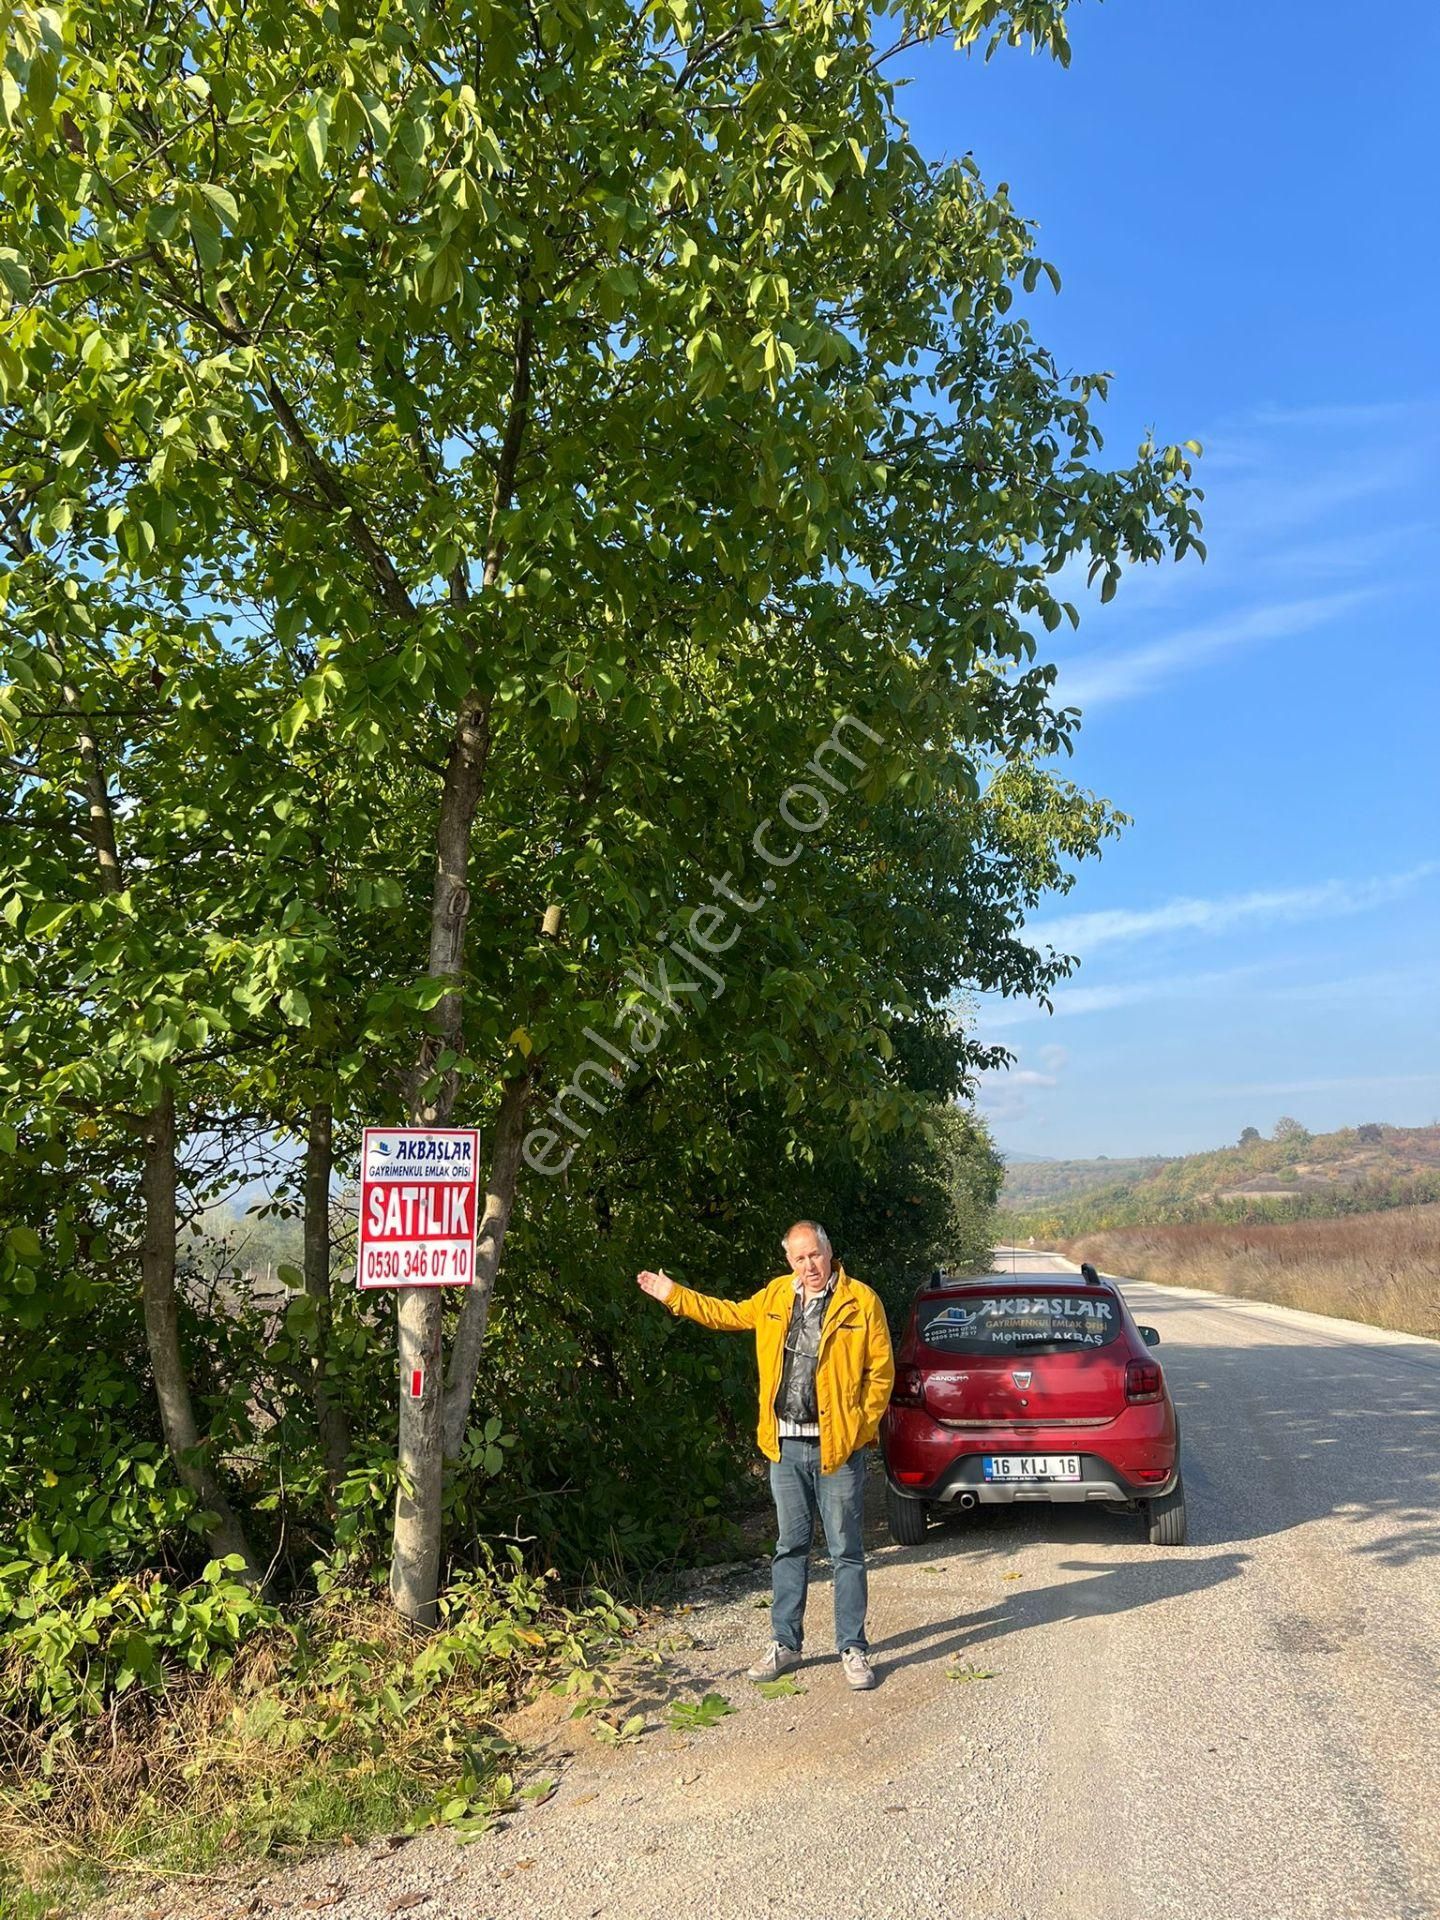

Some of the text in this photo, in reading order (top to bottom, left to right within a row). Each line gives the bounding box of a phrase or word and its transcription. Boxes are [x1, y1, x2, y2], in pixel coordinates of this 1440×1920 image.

[396, 1140, 471, 1163] AKBAŞLAR
[369, 1162, 471, 1177] GAYRİMENKUL EMLAK OFİSİ
[368, 1186, 471, 1237] SATILIK
[368, 1248, 467, 1279] 0530 346 07 10
[979, 1298, 1112, 1319] AKBAŞLAR
[1052, 1320, 1082, 1329] EMLAK
[992, 1332, 1103, 1345] Mehmet AKBAŞ
[993, 1458, 1076, 1475] 16 KIJ 16
